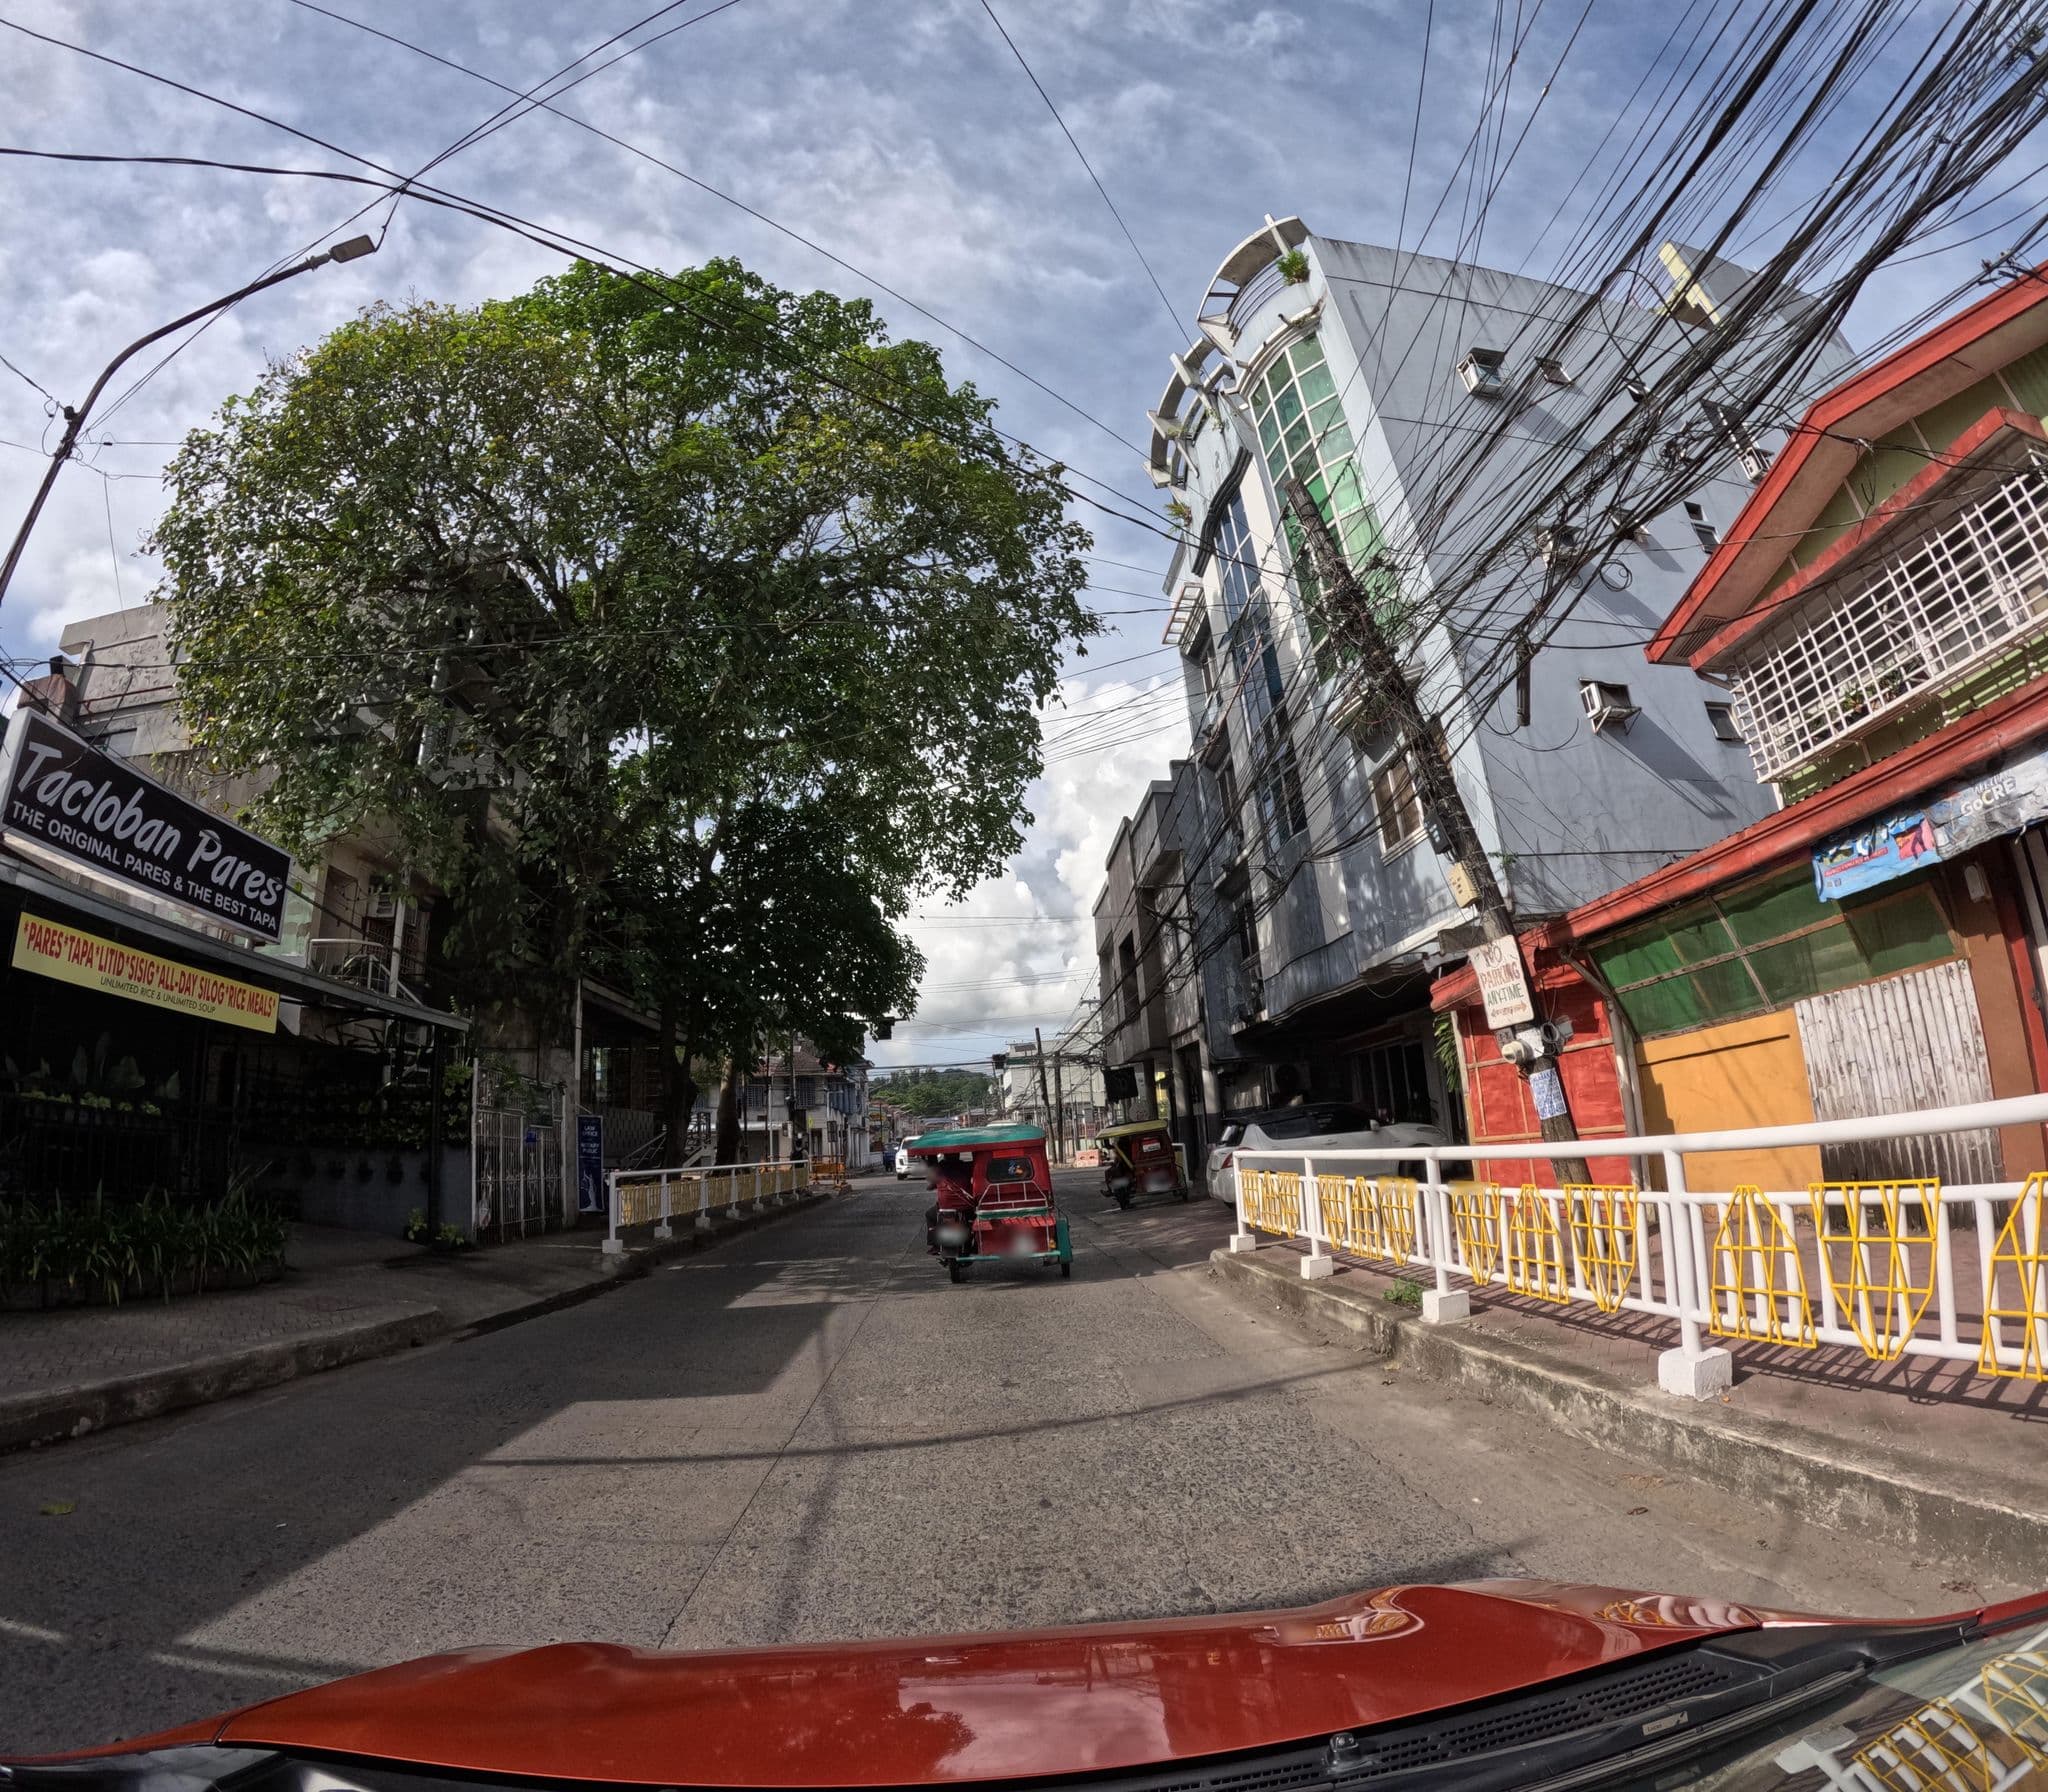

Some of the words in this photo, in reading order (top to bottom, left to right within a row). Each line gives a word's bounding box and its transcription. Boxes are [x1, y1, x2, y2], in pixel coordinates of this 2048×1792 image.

[17, 741, 181, 862] Tacloban
[186, 829, 284, 906] Pares
[11, 801, 45, 832] THE
[47, 817, 121, 868] ORIGINAL
[124, 853, 171, 886] PARES
[173, 875, 184, 892] &
[187, 880, 213, 905] THE
[214, 892, 247, 919] BEST
[249, 906, 277, 931] TAPA
[100, 977, 140, 995] UNLIMITED
[140, 986, 155, 999] RICE
[162, 993, 198, 1010] UNLIMITED
[198, 1001, 216, 1015] SOUP
[1480, 961, 1521, 990] PARKING
